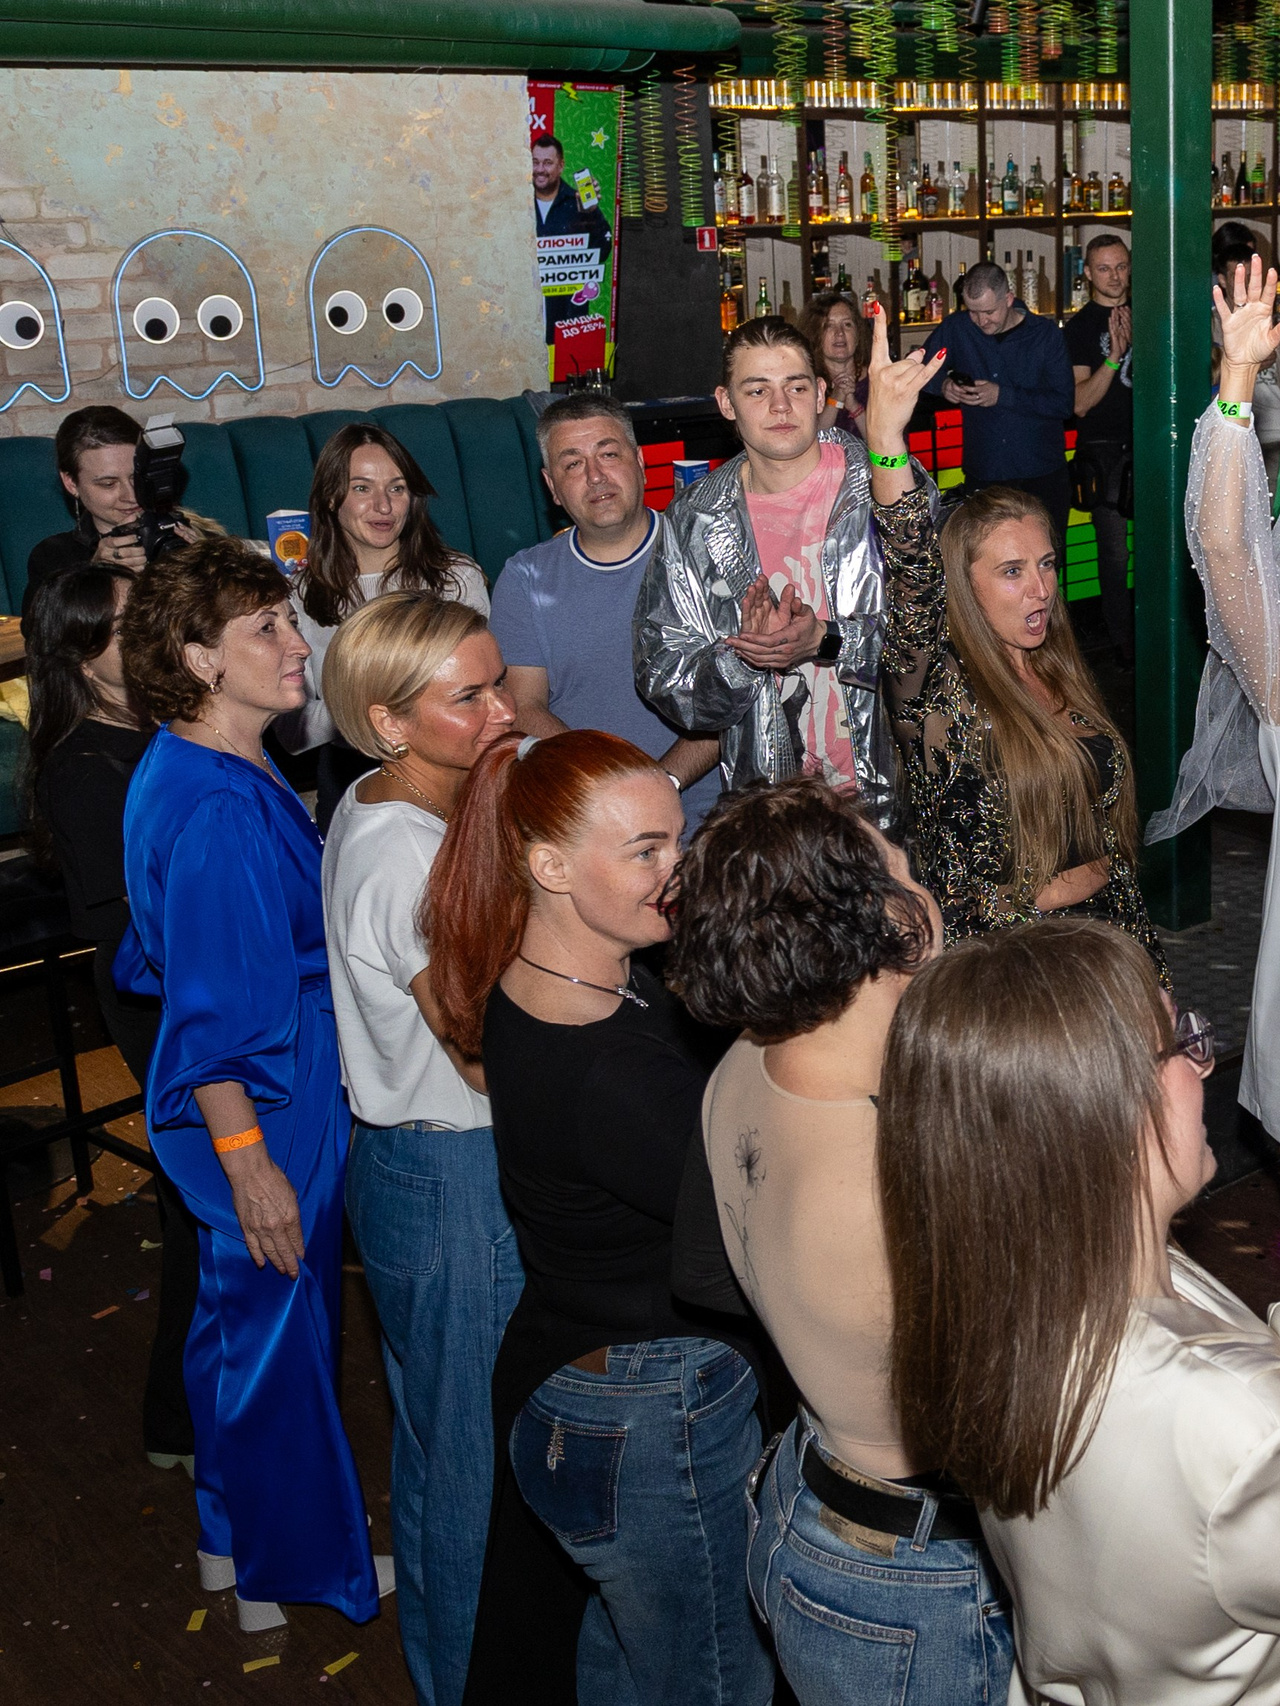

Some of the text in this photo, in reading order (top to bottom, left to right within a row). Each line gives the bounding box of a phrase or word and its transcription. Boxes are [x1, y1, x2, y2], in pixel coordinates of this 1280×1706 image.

[537, 252, 595, 266] РАММУ
[555, 312, 605, 329] СКИДКА
[562, 321, 607, 338] ДО 25%
[1220, 402, 1238, 416] 26
[880, 456, 898, 468] 28
